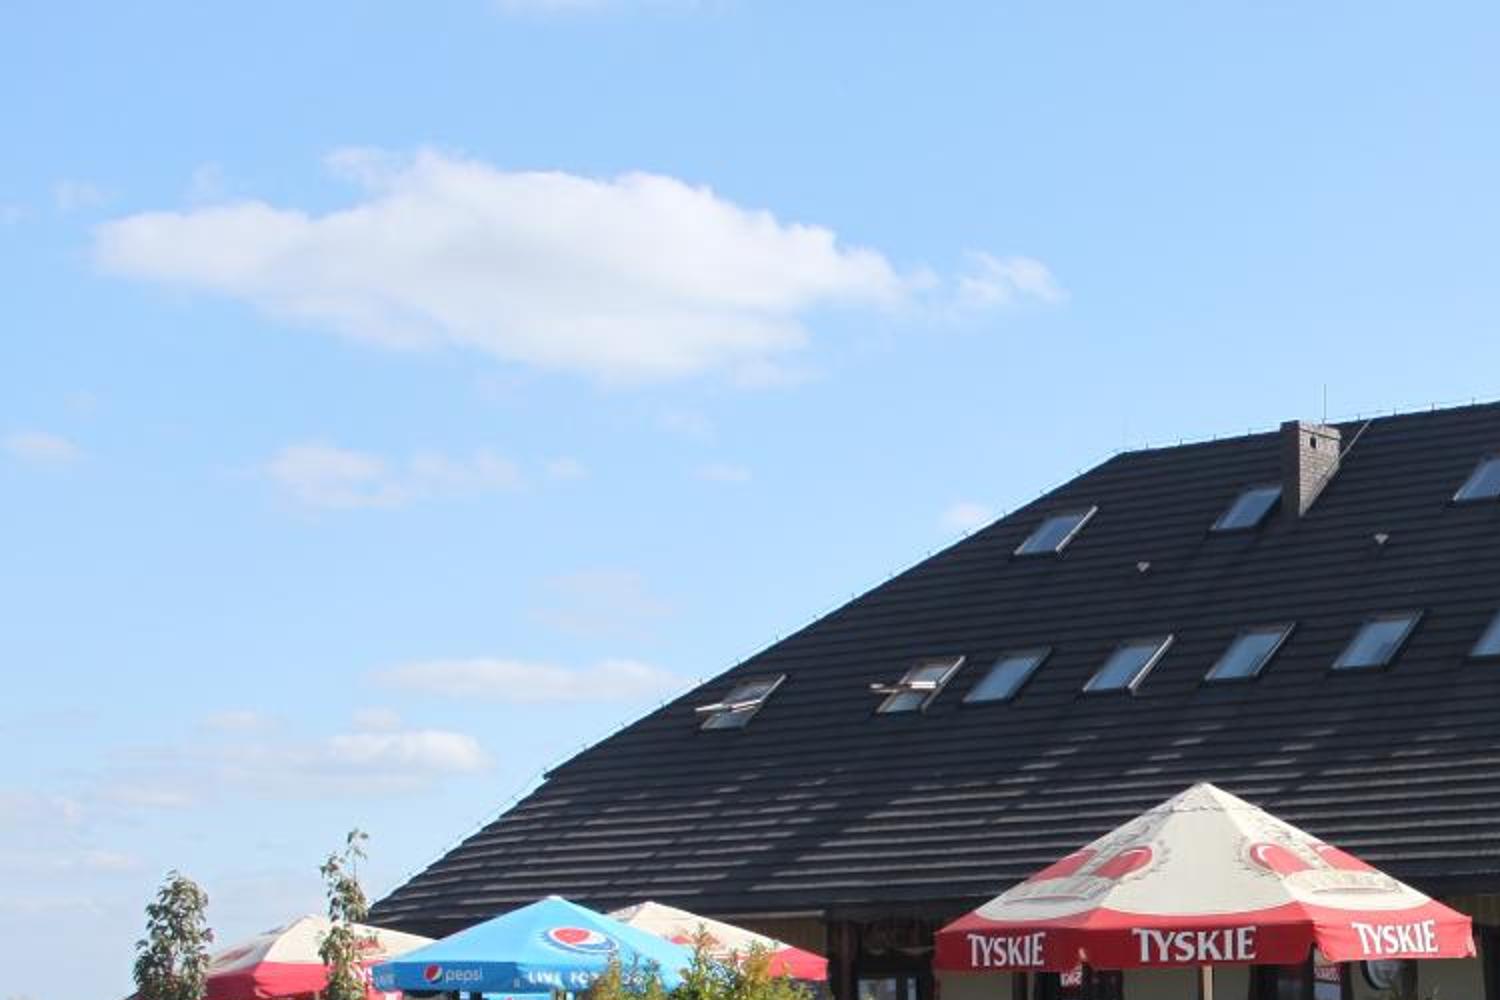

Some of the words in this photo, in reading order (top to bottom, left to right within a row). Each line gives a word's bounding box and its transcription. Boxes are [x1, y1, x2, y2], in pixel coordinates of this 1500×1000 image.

[967, 932, 1046, 967] TYSKIE
[1132, 926, 1256, 962] TYSKIE
[1351, 918, 1439, 955] TYSKIE
[445, 968, 483, 983] pepsi
